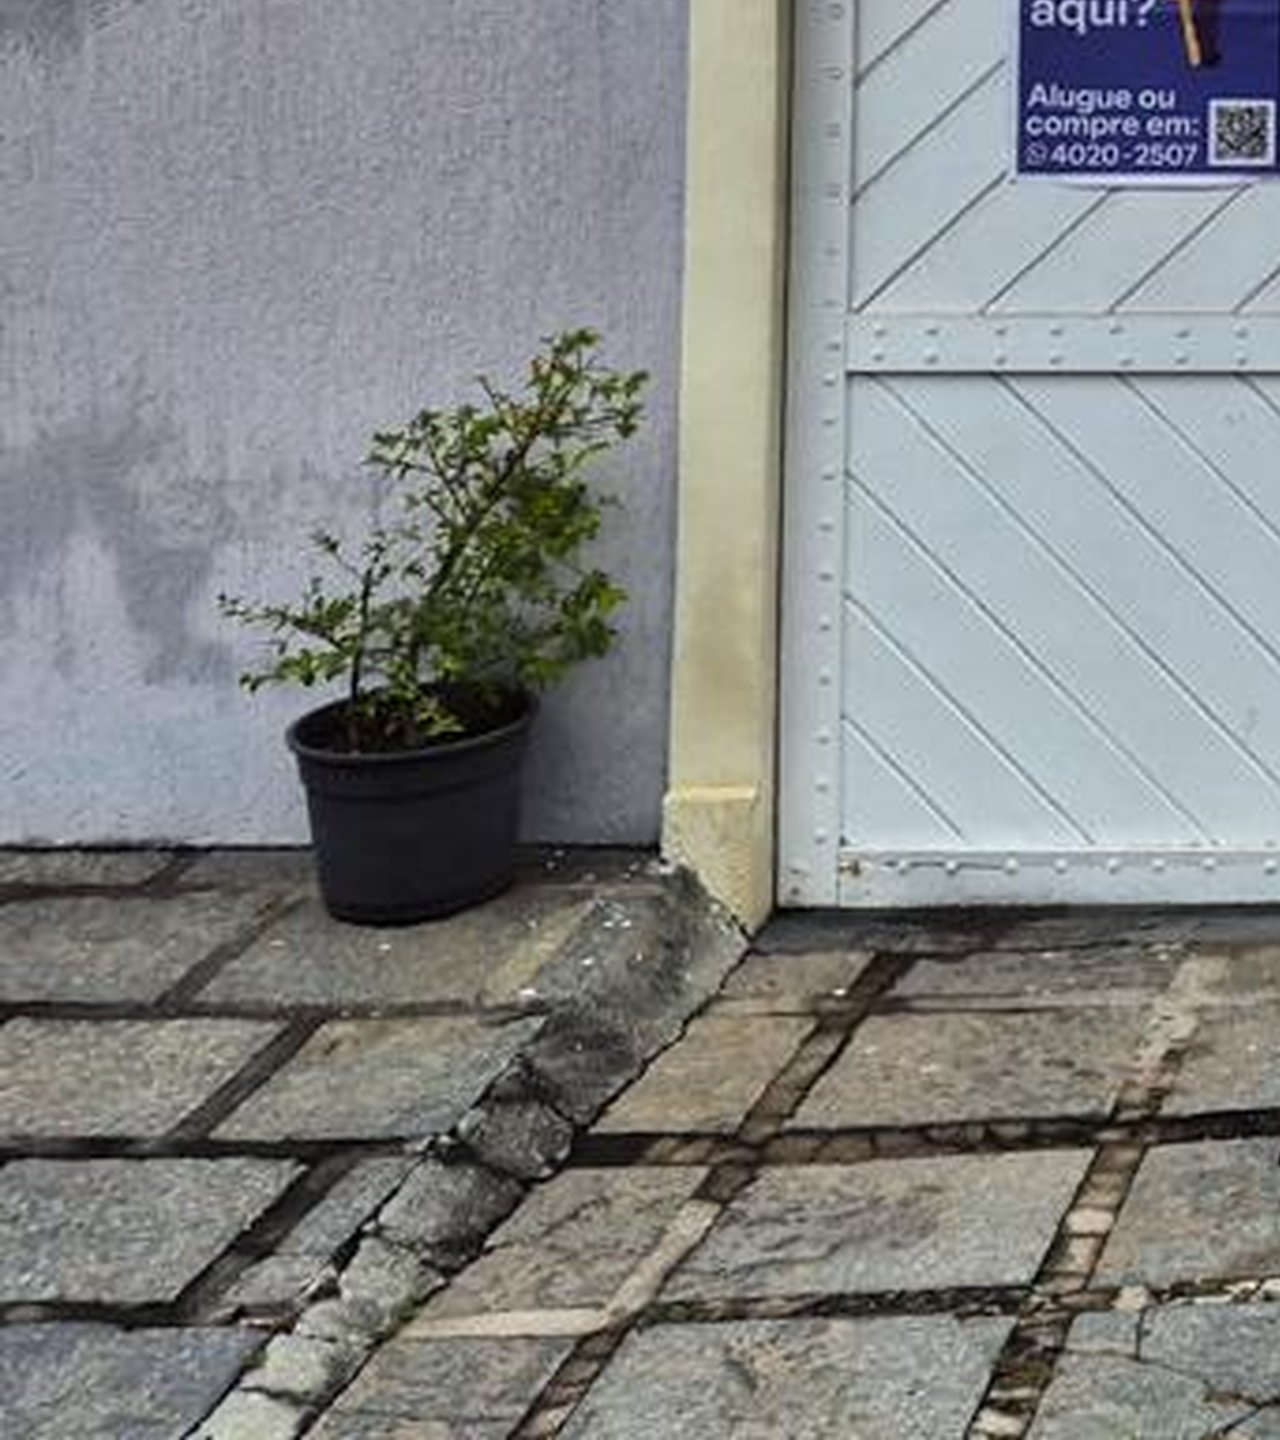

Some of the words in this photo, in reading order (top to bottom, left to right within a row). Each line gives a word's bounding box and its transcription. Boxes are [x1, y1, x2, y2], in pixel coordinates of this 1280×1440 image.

[1026, 83, 1133, 114] Alugue
[1137, 88, 1176, 110] ou
[1025, 115, 1140, 140] compre
[1146, 115, 1199, 137] em:
[1051, 142, 1199, 166] 4020-2507
